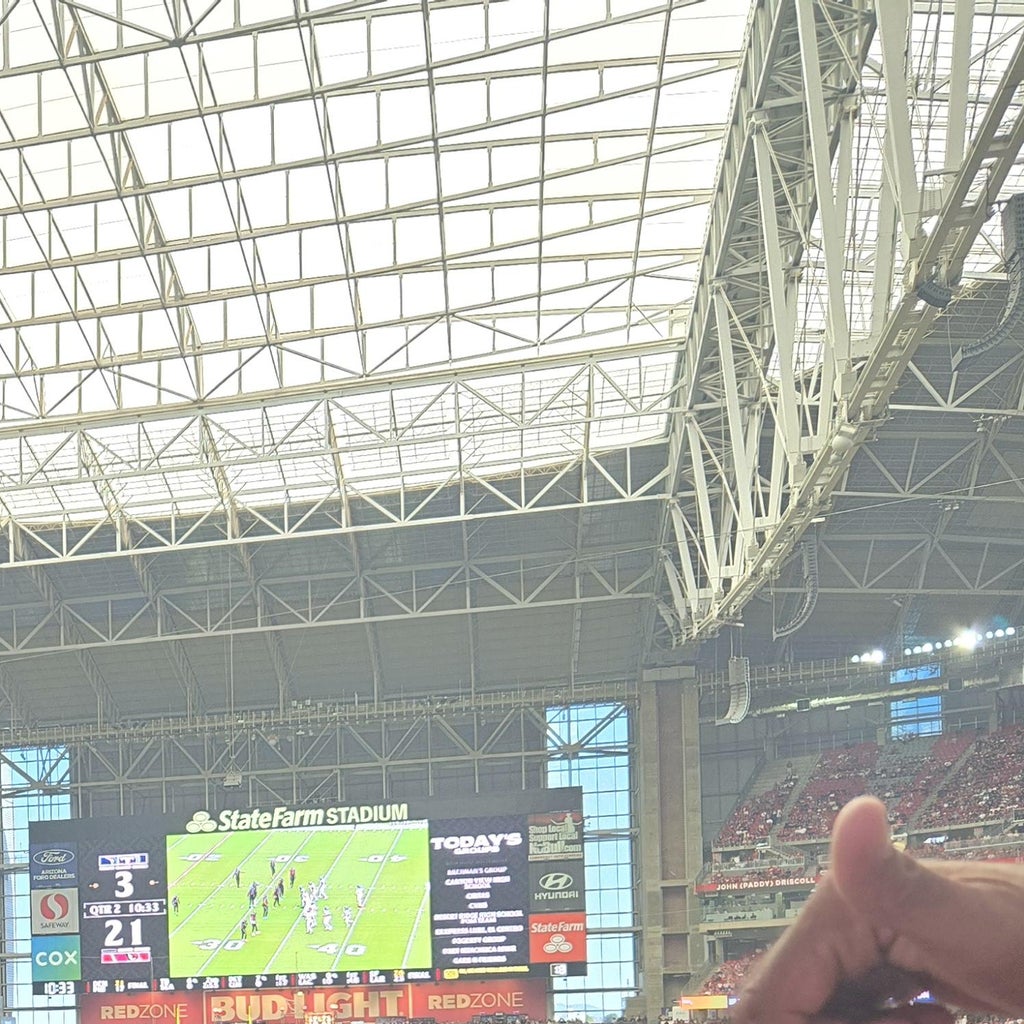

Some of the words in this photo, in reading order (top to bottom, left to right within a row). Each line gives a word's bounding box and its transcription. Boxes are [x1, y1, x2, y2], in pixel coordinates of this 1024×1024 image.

[326, 803, 408, 825] STADIUM
[430, 833, 522, 850] TODAY'S
[41, 852, 66, 863] Ford
[115, 871, 134, 898] 3
[739, 881, 774, 889] (PADDY)
[535, 891, 578, 900] HYUNDAI
[89, 904, 112, 915] QTR
[114, 904, 121, 914] 2
[129, 902, 160, 913] 10:33
[104, 918, 143, 947] 21
[36, 950, 78, 966] COX
[44, 981, 75, 994] 10:33
[211, 994, 288, 1022] BUD
